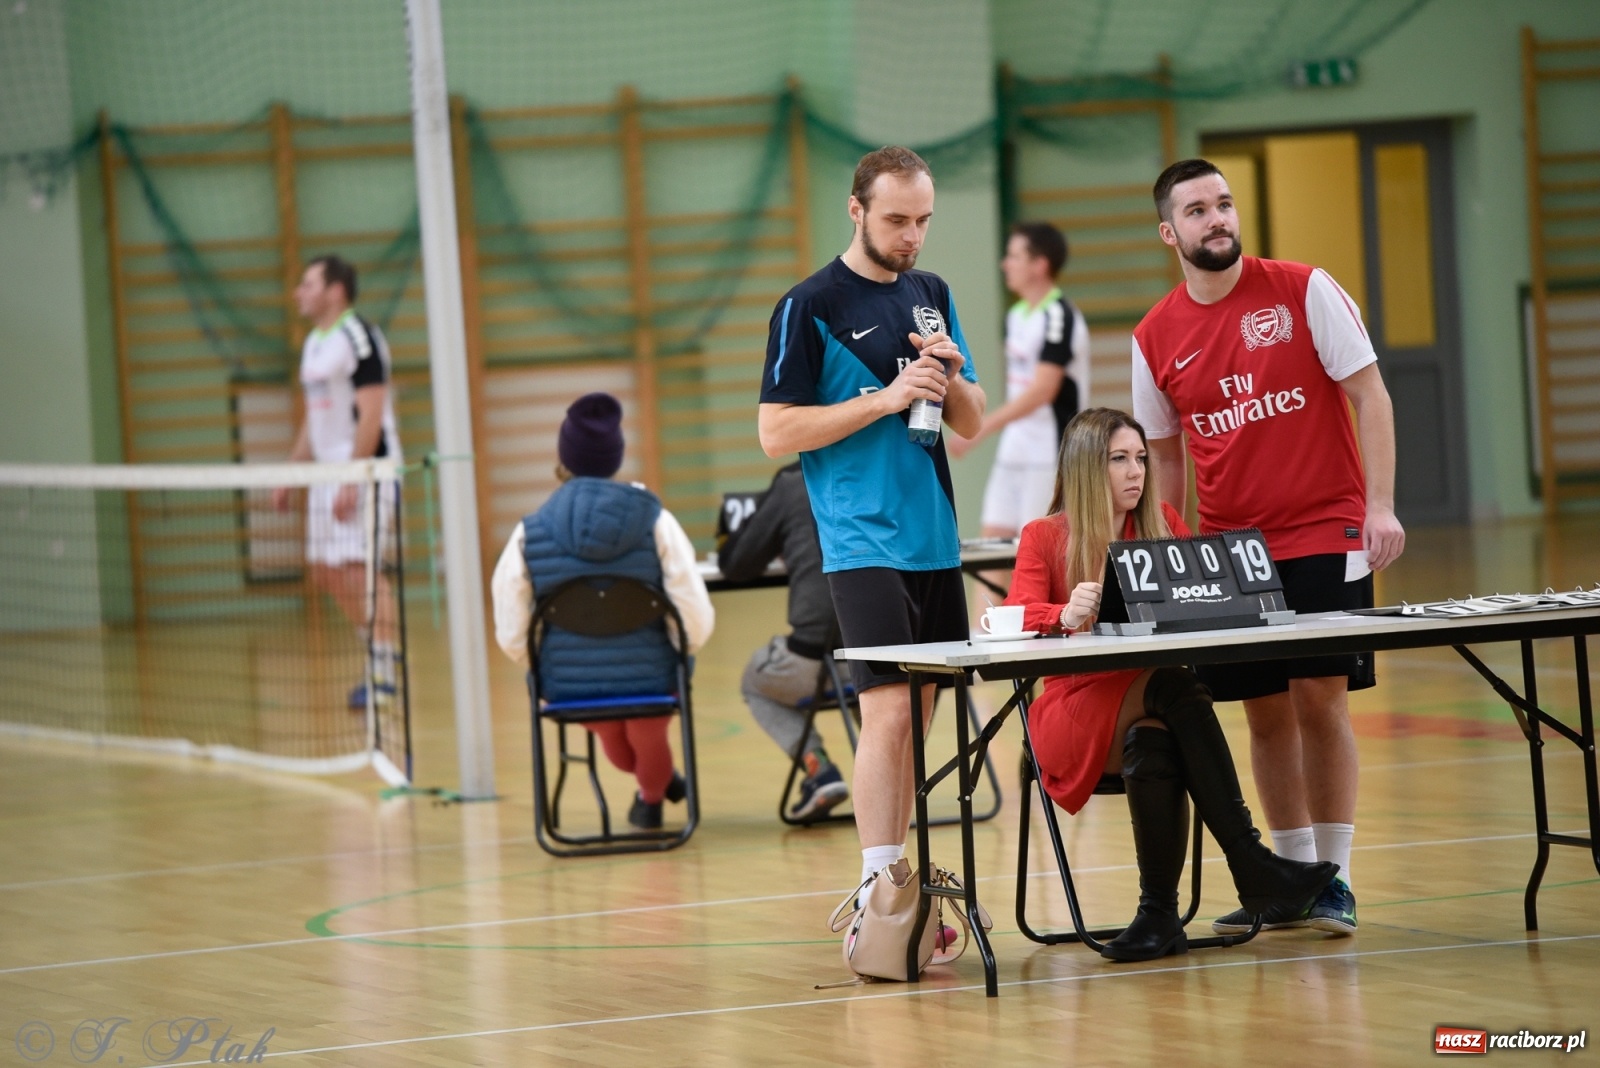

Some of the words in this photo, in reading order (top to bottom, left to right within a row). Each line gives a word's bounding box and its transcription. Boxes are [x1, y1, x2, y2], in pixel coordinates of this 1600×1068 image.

[1219, 373, 1253, 399] Fly
[1191, 387, 1306, 438] Emirates
[1117, 549, 1159, 592] 12
[1167, 545, 1187, 575] 0
[1200, 543, 1221, 574] 0
[1230, 539, 1273, 583] 19
[1172, 583, 1223, 600] JOOLA
